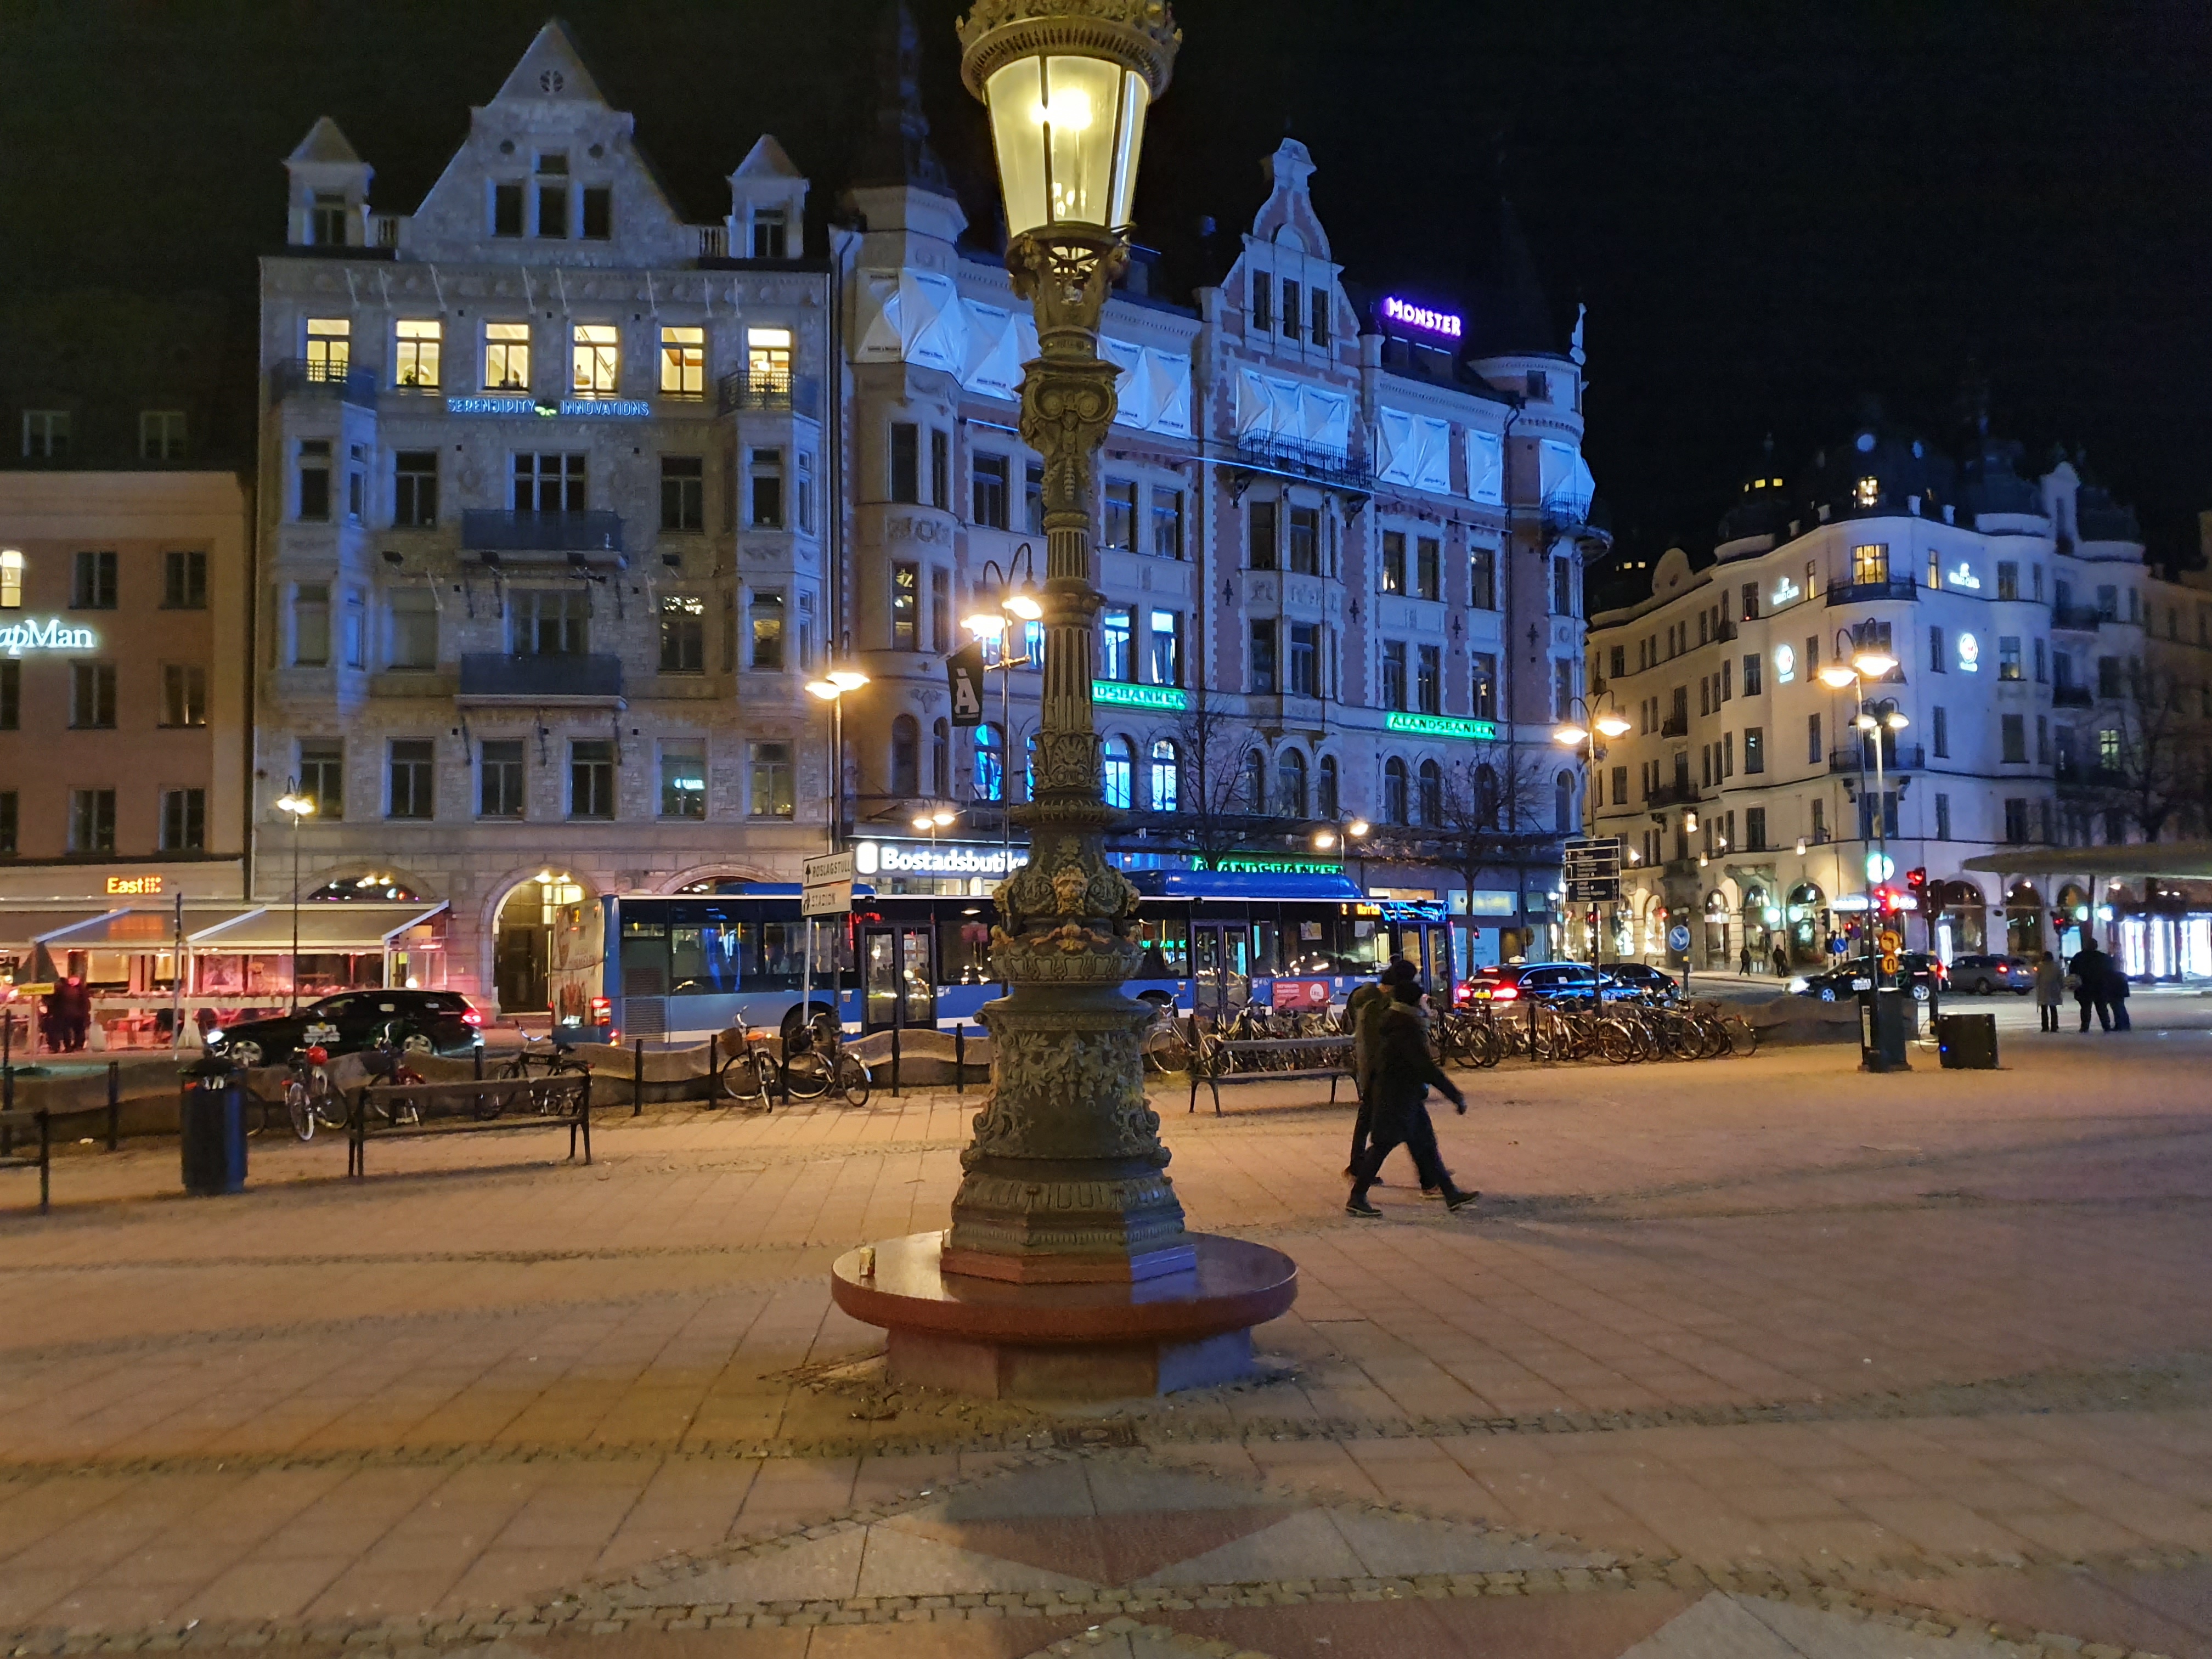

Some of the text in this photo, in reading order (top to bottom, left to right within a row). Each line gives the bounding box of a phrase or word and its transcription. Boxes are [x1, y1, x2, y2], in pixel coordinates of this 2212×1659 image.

[1385, 296, 1461, 336] MONSTER
[447, 398, 650, 416] SERENDIPITY INNOVATIONS
[812, 860, 850, 878] ROSLAGSTULL
[812, 893, 836, 907] STADION
